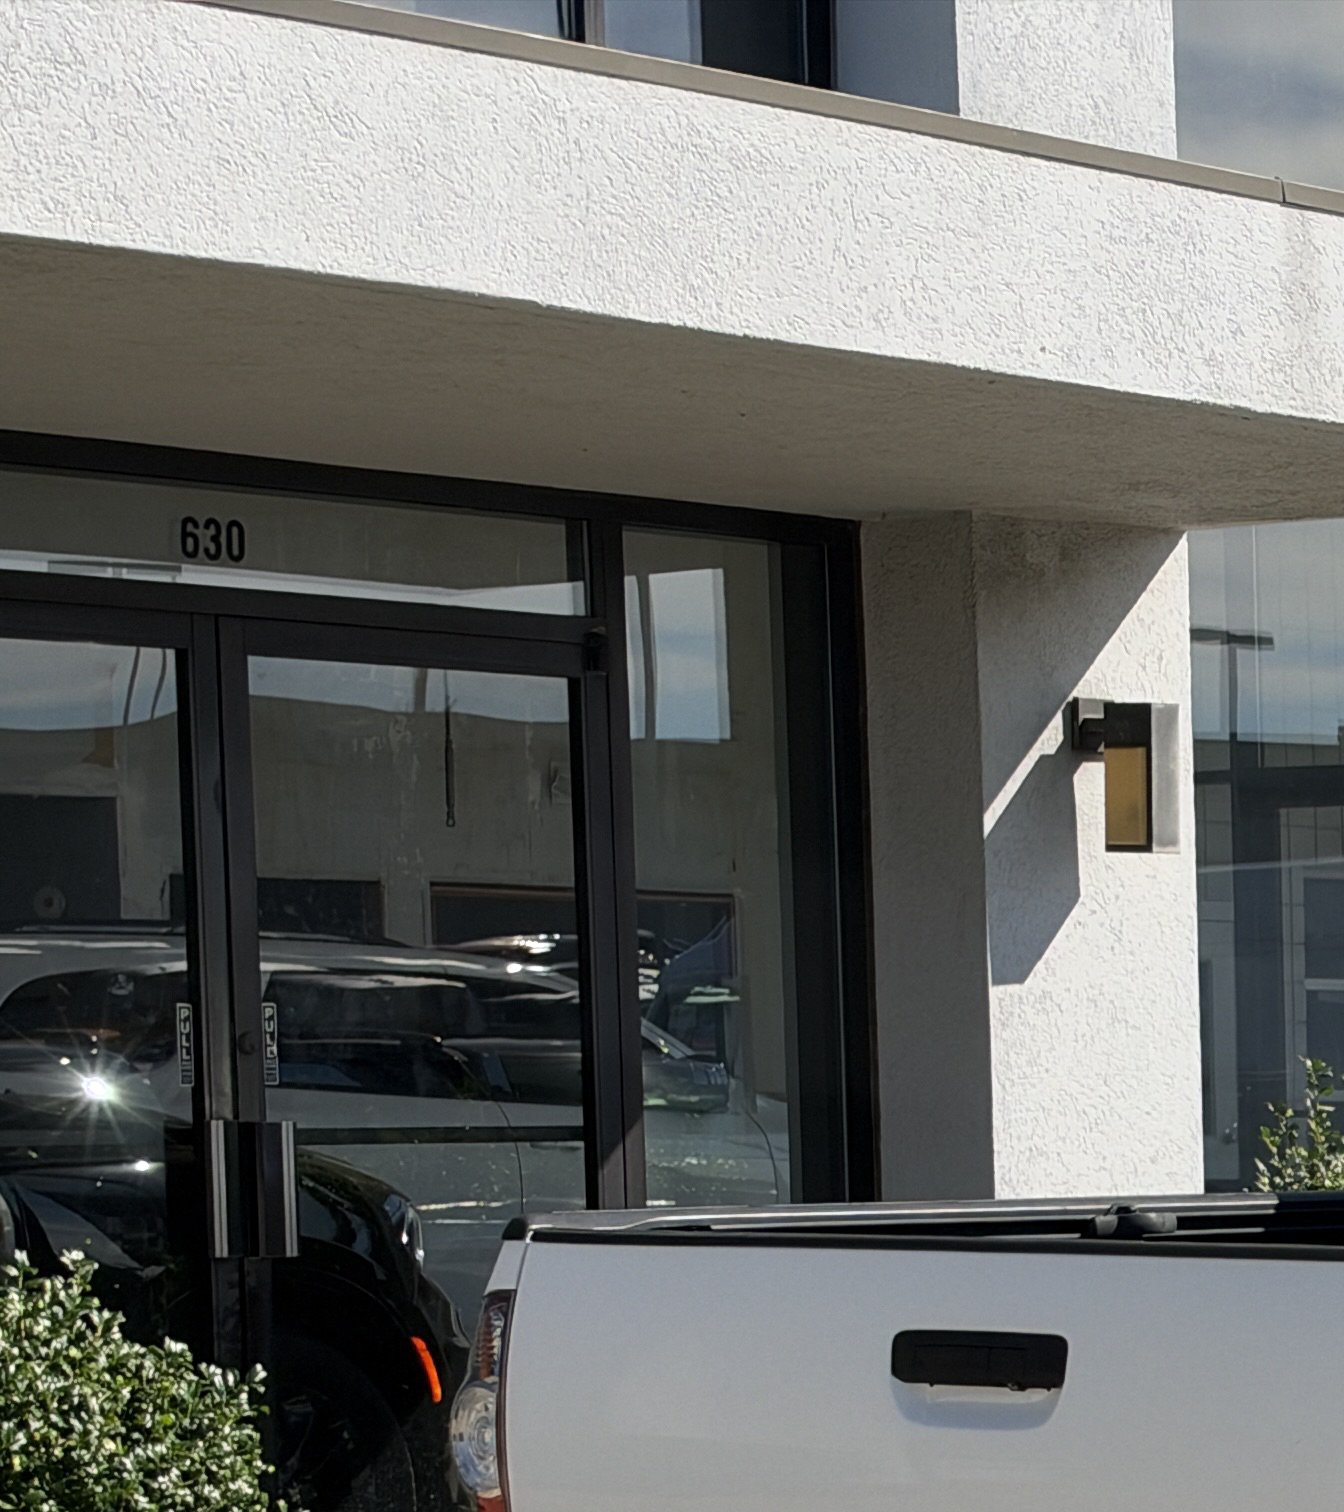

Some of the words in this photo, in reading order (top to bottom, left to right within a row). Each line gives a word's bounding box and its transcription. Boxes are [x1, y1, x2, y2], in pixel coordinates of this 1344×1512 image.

[181, 516, 246, 563] 630
[180, 1008, 191, 1060] PULL
[264, 1007, 277, 1059] PULL
